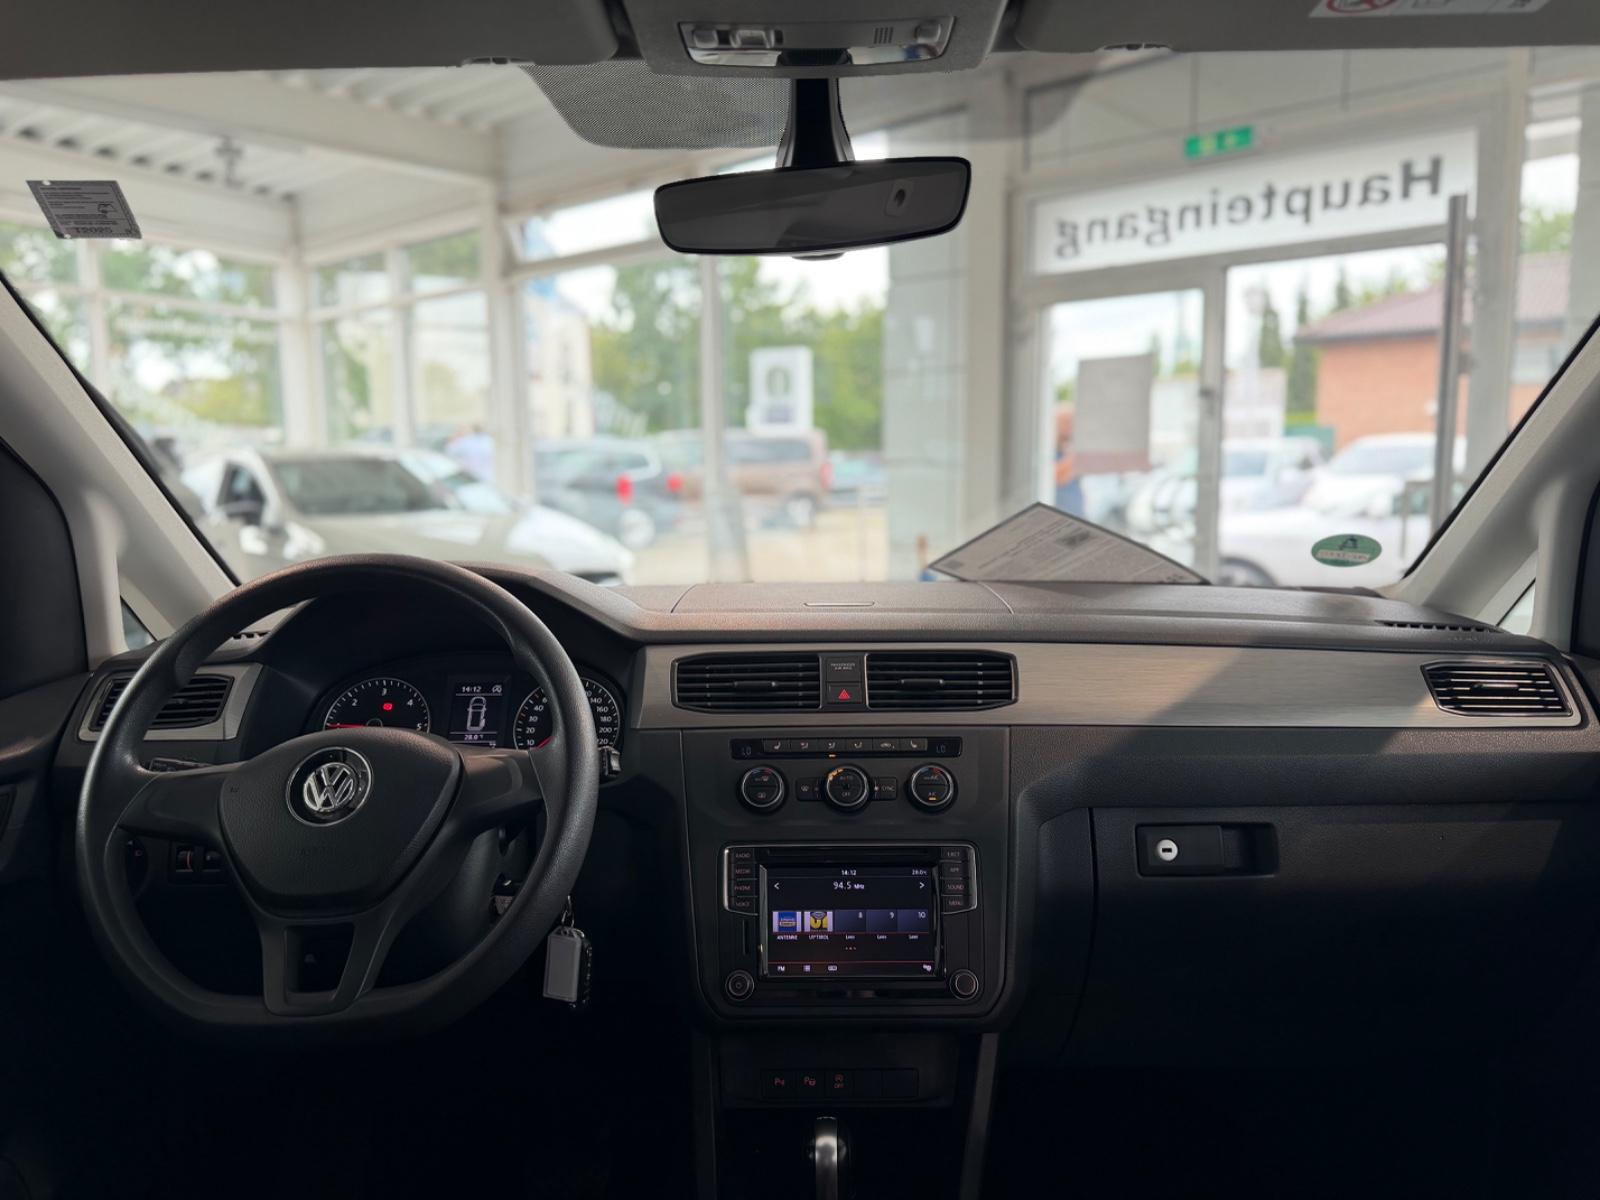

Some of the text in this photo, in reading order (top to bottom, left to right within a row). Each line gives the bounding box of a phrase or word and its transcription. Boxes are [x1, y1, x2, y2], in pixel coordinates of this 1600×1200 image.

[381, 689, 388, 697] 3
[351, 699, 359, 707] 2
[590, 697, 603, 705] 140
[533, 704, 544, 712] 40
[596, 705, 609, 713] 160
[600, 715, 612, 723] 180
[416, 723, 423, 731] 5
[833, 881, 852, 890] 94.5
[857, 911, 863, 919] 8
[889, 911, 895, 919] 9
[917, 911, 926, 919] 10
